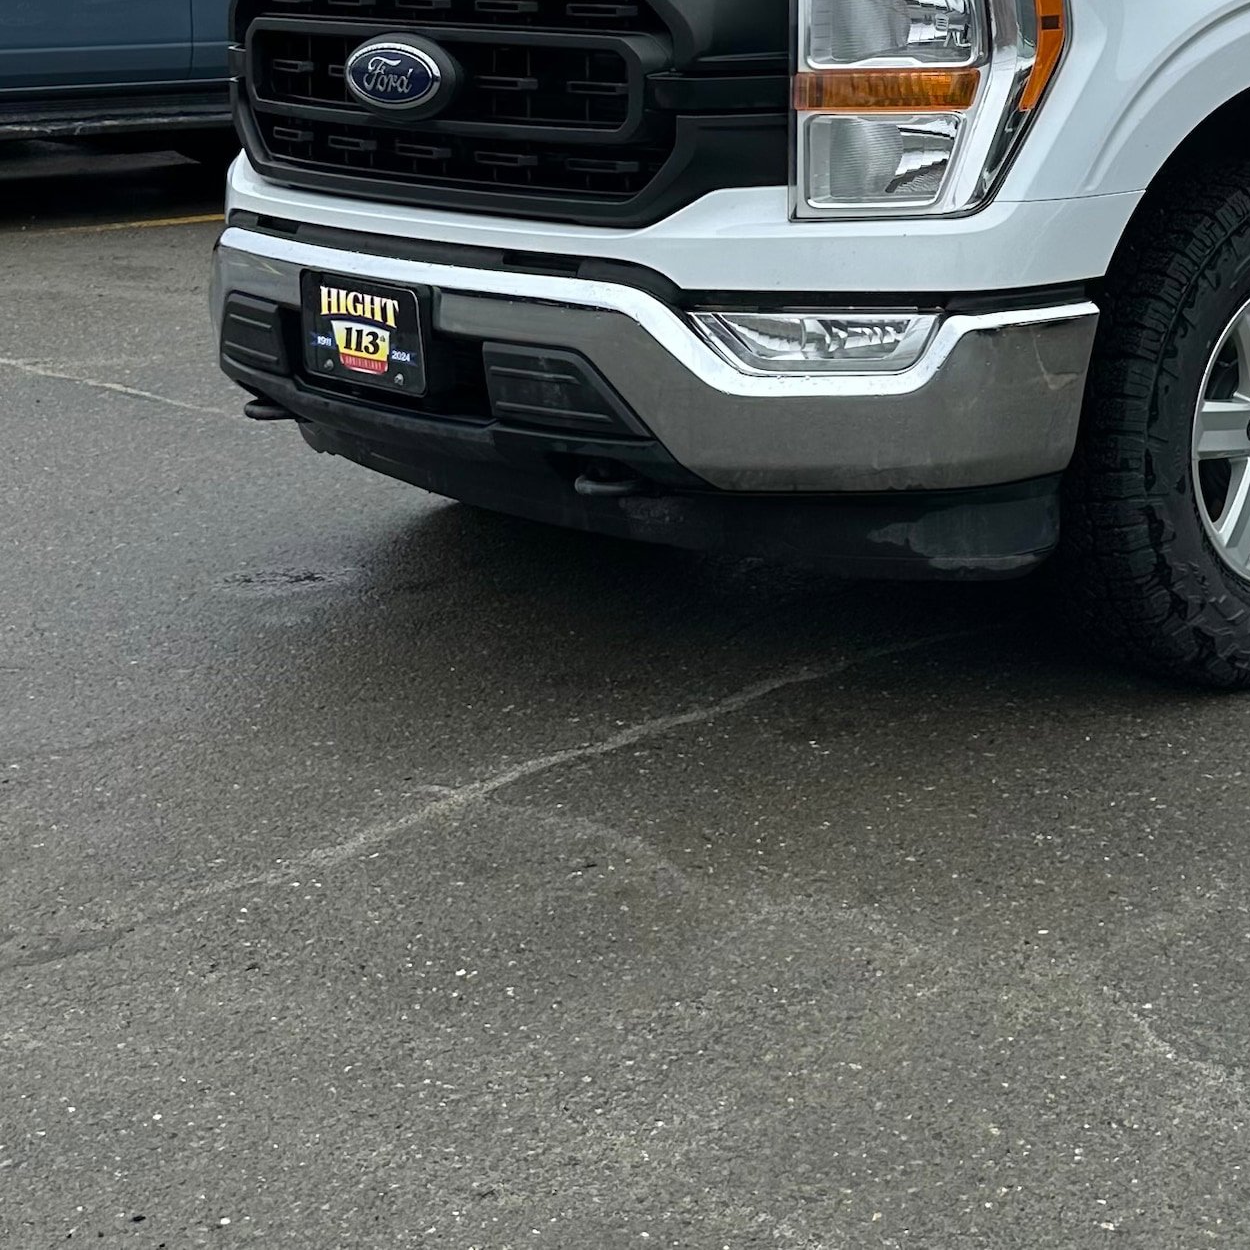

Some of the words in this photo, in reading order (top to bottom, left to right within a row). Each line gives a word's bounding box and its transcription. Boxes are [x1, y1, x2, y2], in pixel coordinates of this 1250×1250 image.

[363, 56, 414, 94] Ford
[320, 285, 399, 329] HIGHT
[391, 350, 411, 362] 2024
